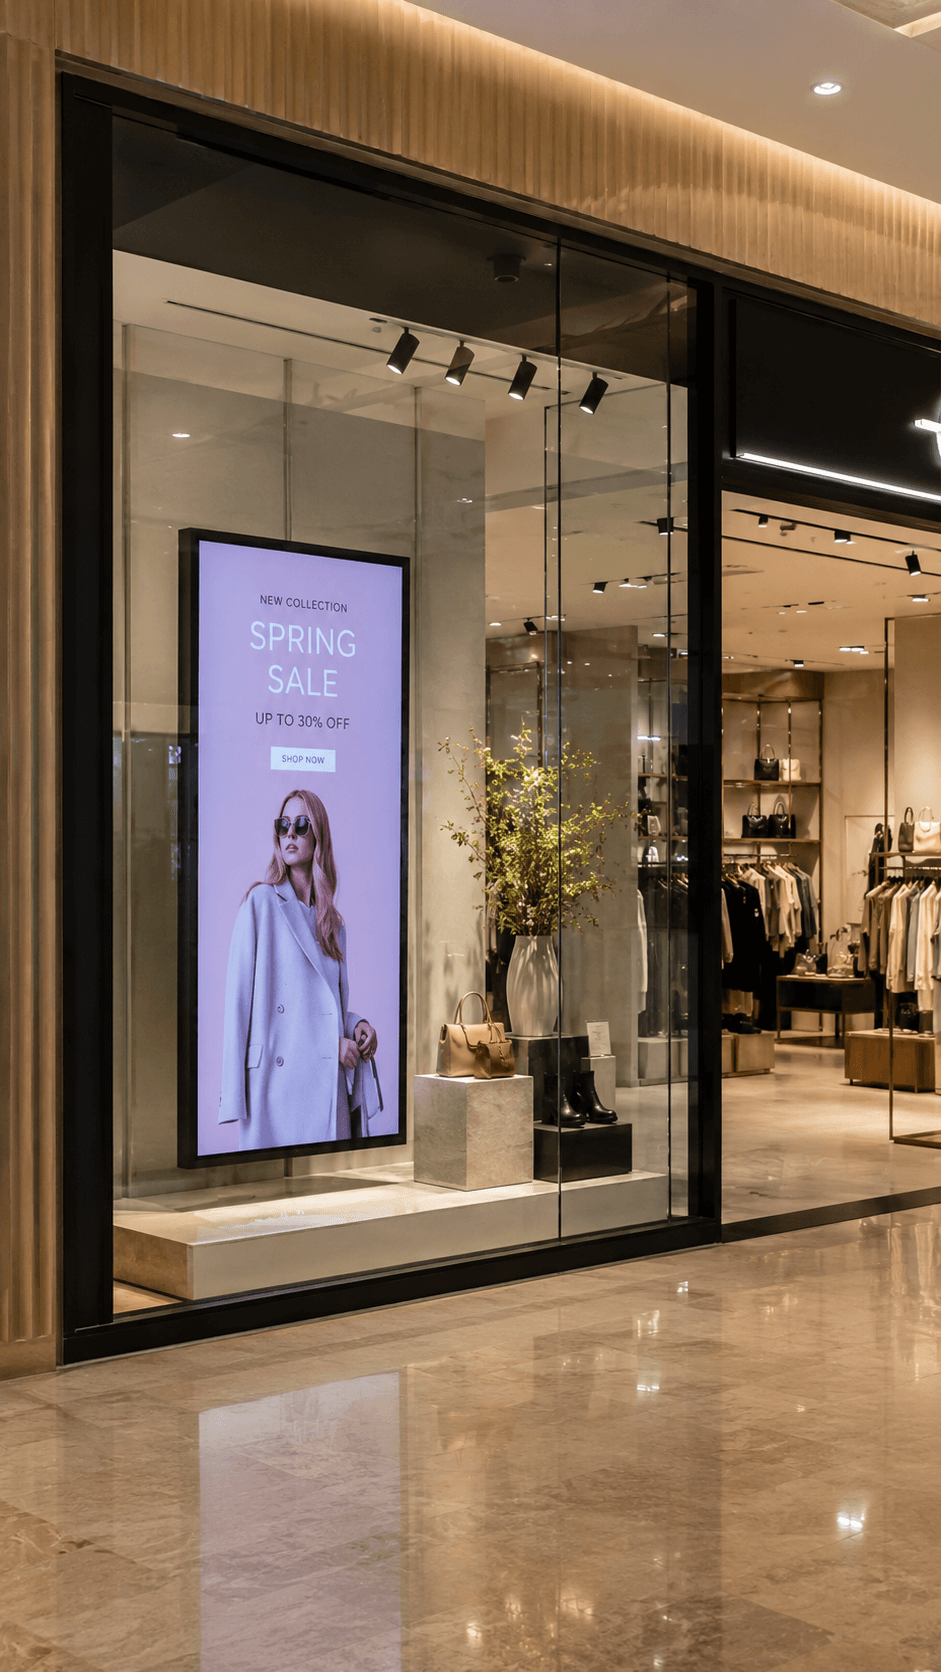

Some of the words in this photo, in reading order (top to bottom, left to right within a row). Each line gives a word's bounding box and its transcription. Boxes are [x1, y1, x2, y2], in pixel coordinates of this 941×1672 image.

[260, 595, 283, 606] NEW
[286, 597, 348, 613] COLLECTION
[250, 620, 356, 658] SPRING
[268, 664, 338, 697] SALE
[255, 712, 273, 725] UP
[277, 713, 294, 726] TO
[298, 715, 323, 728] 30%
[326, 716, 350, 730] OFF
[281, 754, 304, 764] SHOP
[305, 756, 325, 765] NOW
